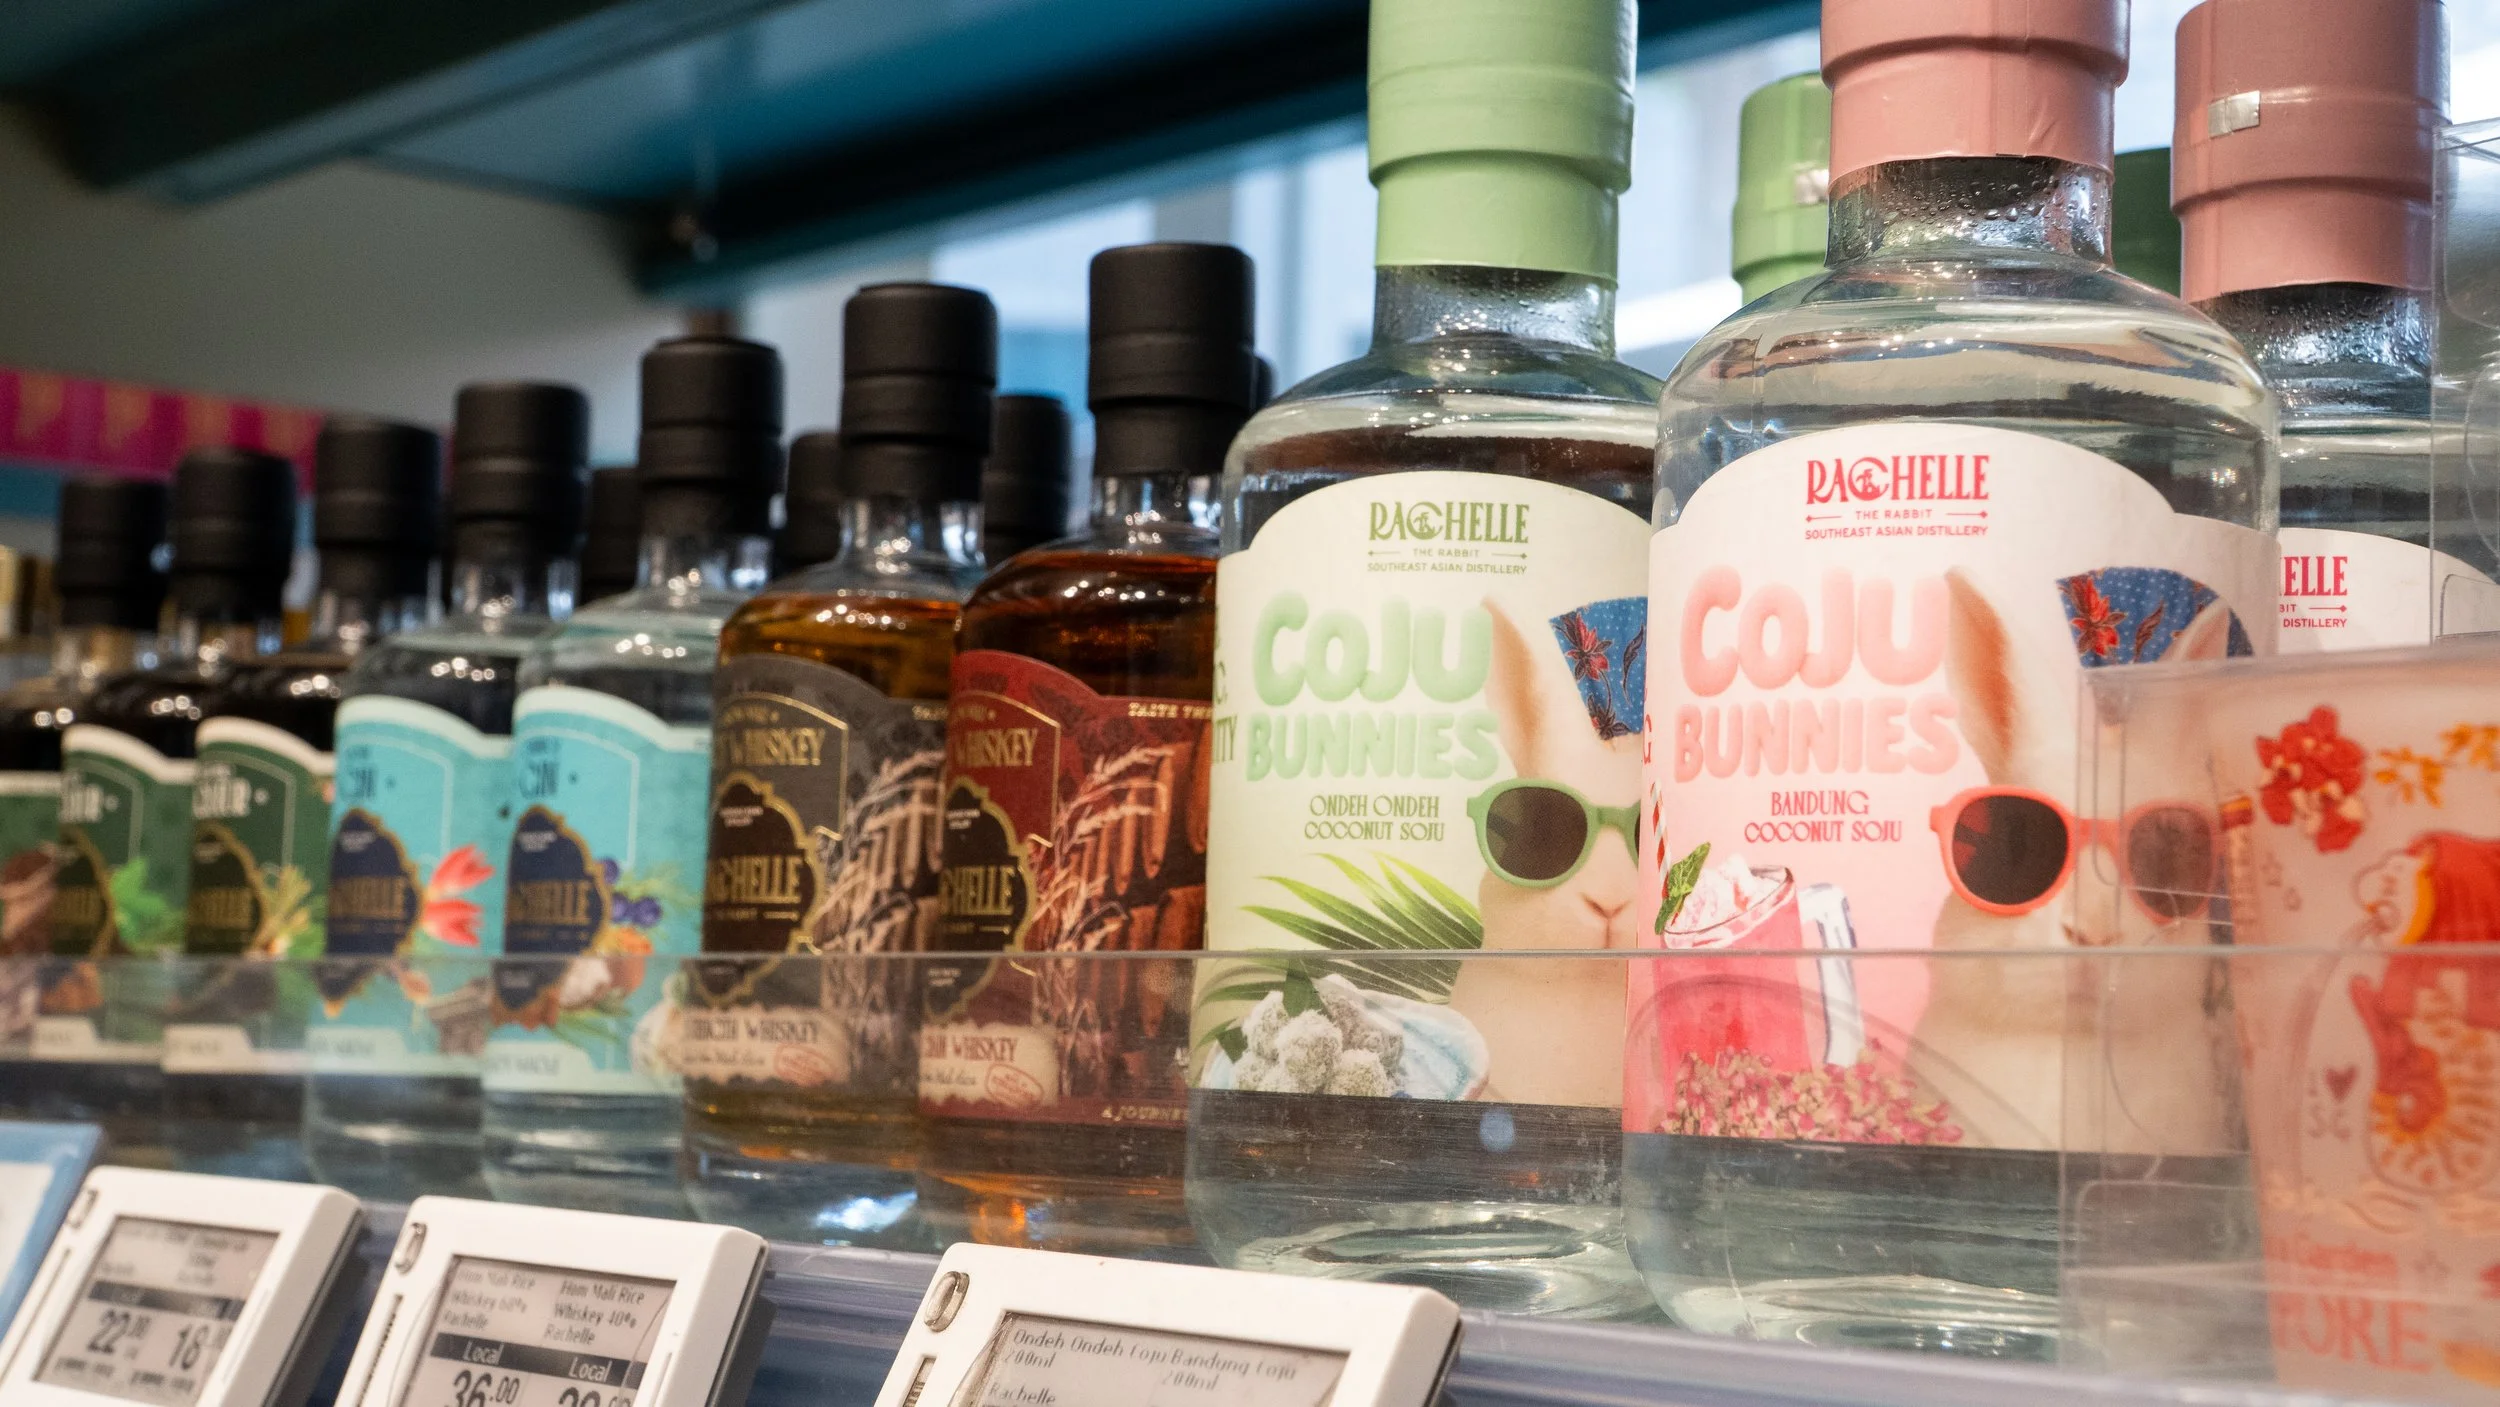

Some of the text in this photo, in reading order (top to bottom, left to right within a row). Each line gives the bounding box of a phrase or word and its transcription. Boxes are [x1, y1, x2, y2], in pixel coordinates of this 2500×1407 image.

[1806, 454, 1990, 505] RACHELLE
[1368, 500, 1530, 544] RACHELLE
[1855, 508, 1933, 520] THE RABBIT
[1804, 525, 1989, 540] SOUTHEAST ASIAN DISTILLERY
[1413, 548, 1481, 559] THE RABBIT
[1367, 562, 1528, 575] SOUTHEAST ASIAN DISTILLERY
[2280, 556, 2348, 596] ELLE
[2282, 618, 2348, 628] DISTILLERY
[1245, 710, 1500, 782] BUNNIES
[1673, 697, 1962, 783] BUNNIES
[1310, 794, 1440, 818] ONDEH ONDEH
[1770, 790, 1870, 817] BANDUNG
[1304, 820, 1445, 842] COCONUT SOJU
[1744, 820, 1903, 843] COCONUT SOJU
[461, 1341, 505, 1367] Local
[1013, 1328, 1065, 1350] Ondeh
[1070, 1335, 1125, 1357] Ondeh
[568, 1356, 613, 1383] Local
[1170, 1348, 1250, 1378] Bandung
[988, 1381, 1057, 1405] Rachelle
